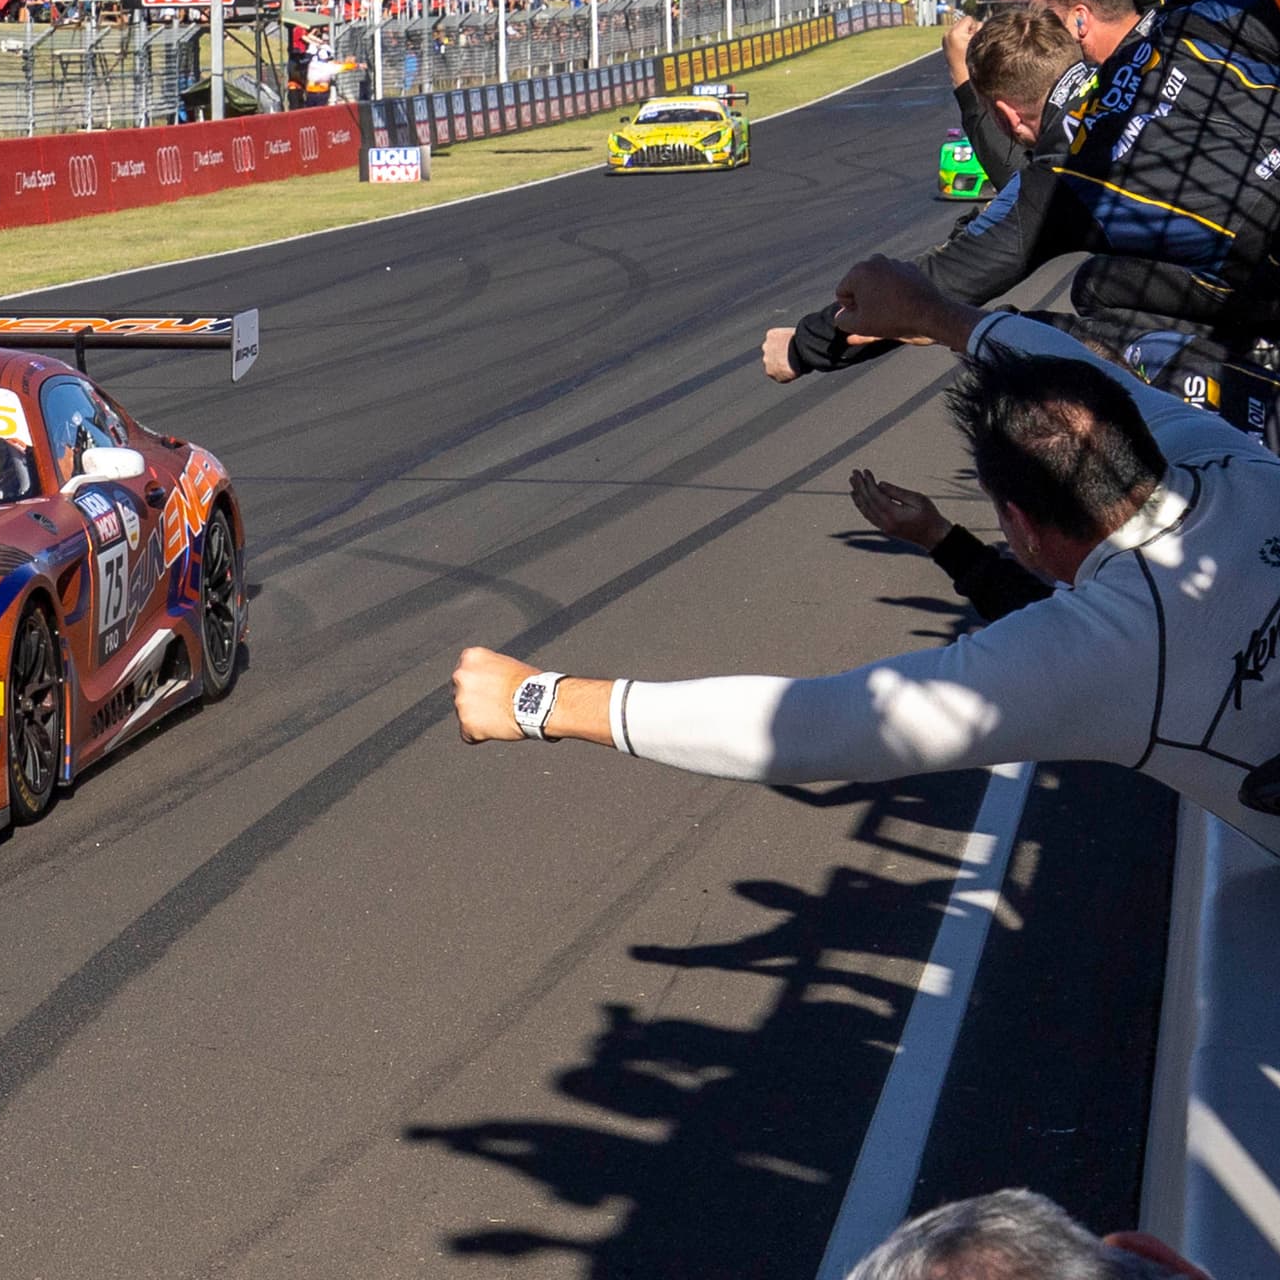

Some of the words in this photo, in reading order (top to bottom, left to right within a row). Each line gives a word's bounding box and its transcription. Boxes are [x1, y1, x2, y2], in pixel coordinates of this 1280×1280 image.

[1163, 66, 1188, 101] OIL
[117, 162, 128, 177] Audi
[129, 159, 146, 176] Sport
[372, 150, 418, 166] LIQUI
[22, 173, 36, 189] Audi
[37, 170, 56, 188] Sport
[371, 165, 419, 181] MOLY
[77, 492, 112, 519] LIQUI
[95, 511, 120, 542] MOLY
[103, 553, 125, 626] 75
[105, 634, 119, 658] PRO
